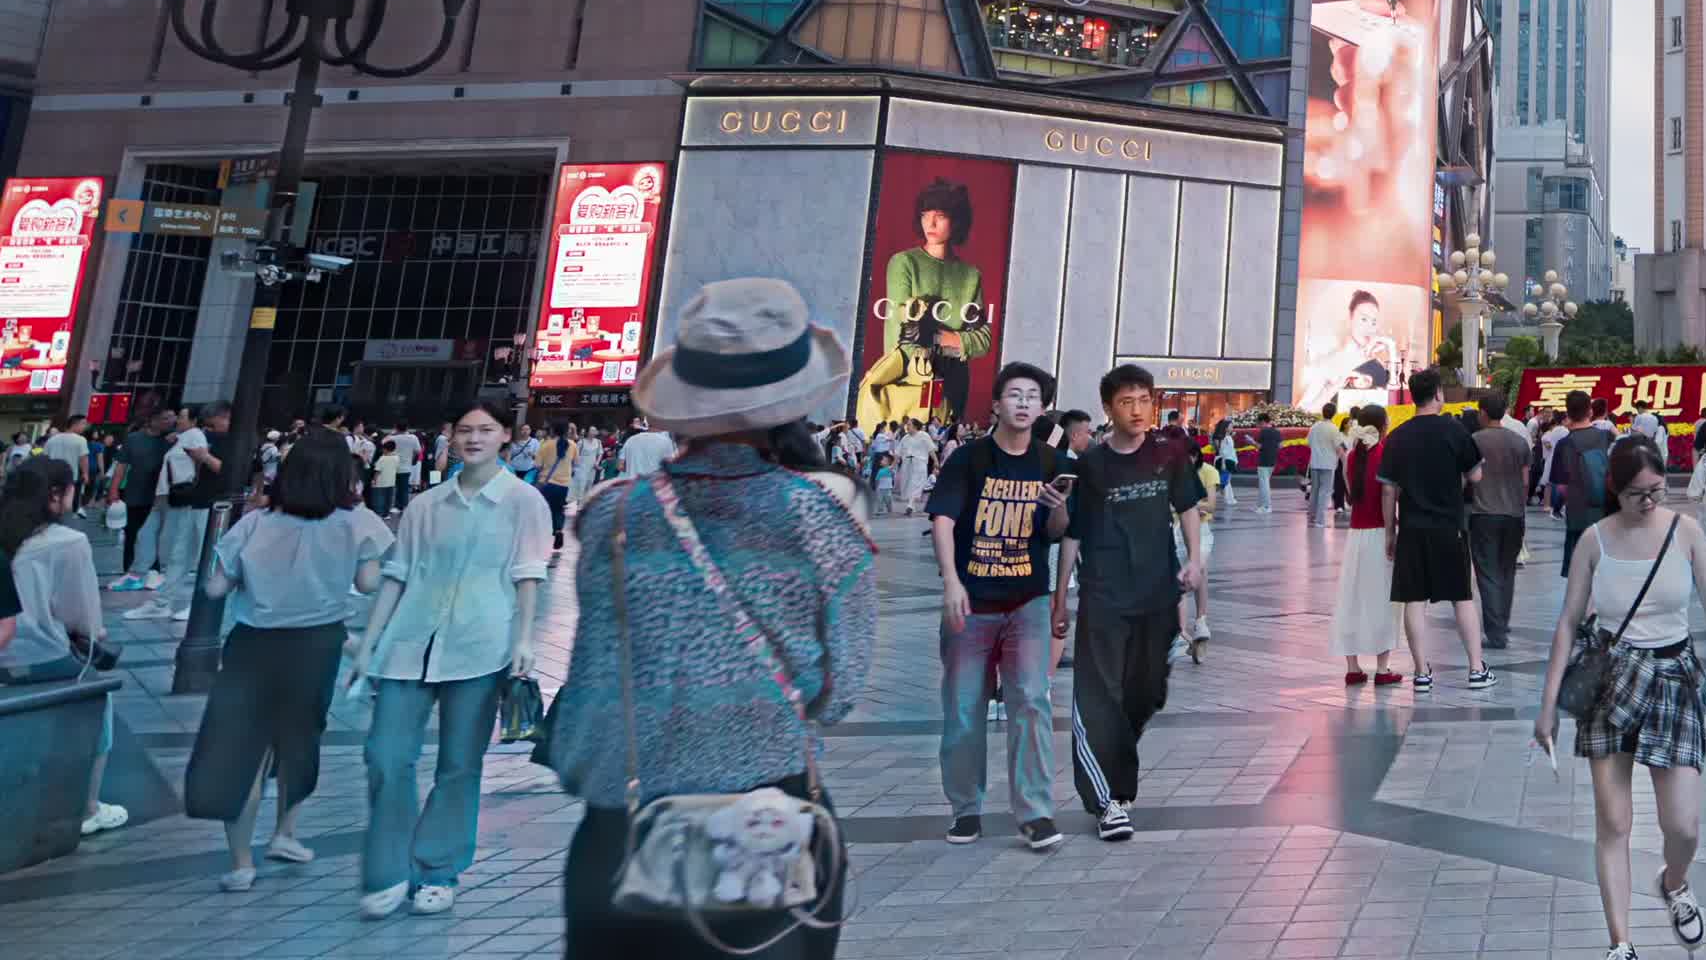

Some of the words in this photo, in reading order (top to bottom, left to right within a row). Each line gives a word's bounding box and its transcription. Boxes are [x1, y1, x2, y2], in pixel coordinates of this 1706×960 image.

[720, 109, 847, 133] GUCCI
[1045, 127, 1153, 161] GUCCI
[873, 297, 996, 324] GUCCI
[539, 393, 563, 404] ICBC
